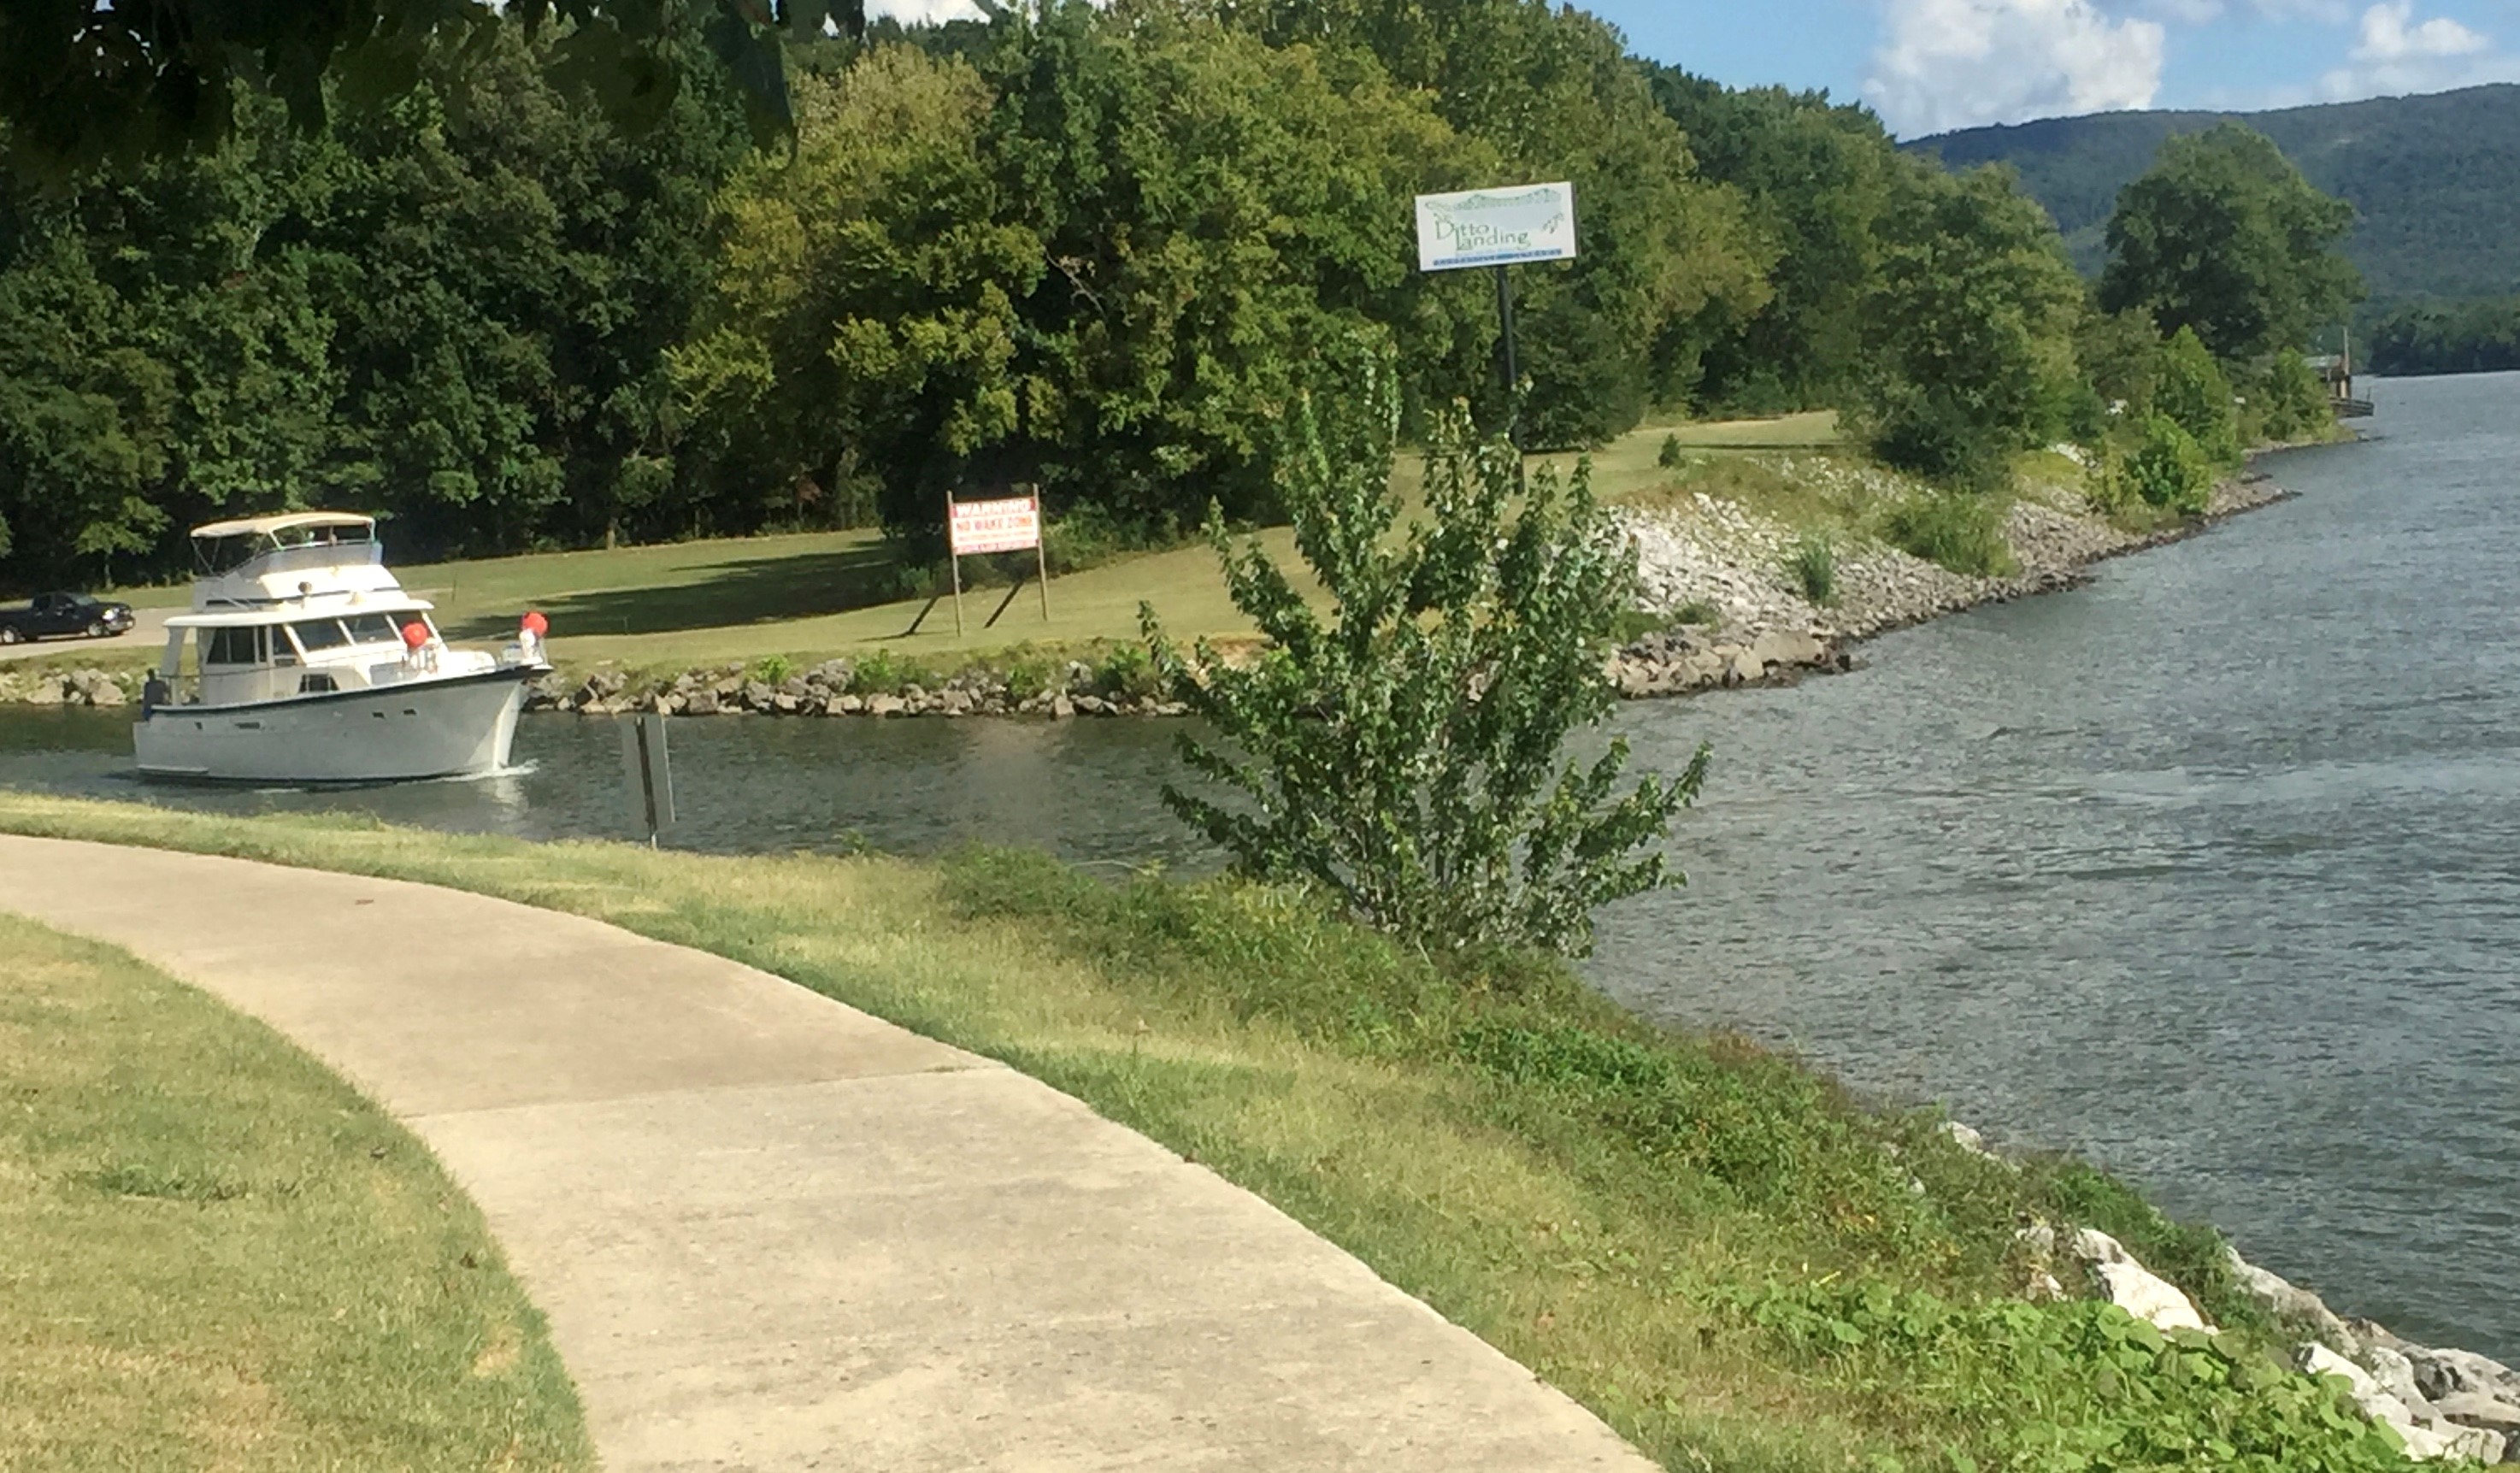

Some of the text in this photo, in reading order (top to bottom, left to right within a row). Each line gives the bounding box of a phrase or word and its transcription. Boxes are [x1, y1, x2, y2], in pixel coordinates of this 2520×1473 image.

[1434, 218, 1489, 240] Ditto
[1455, 226, 1531, 250] Landing
[956, 498, 1030, 517] WARNING
